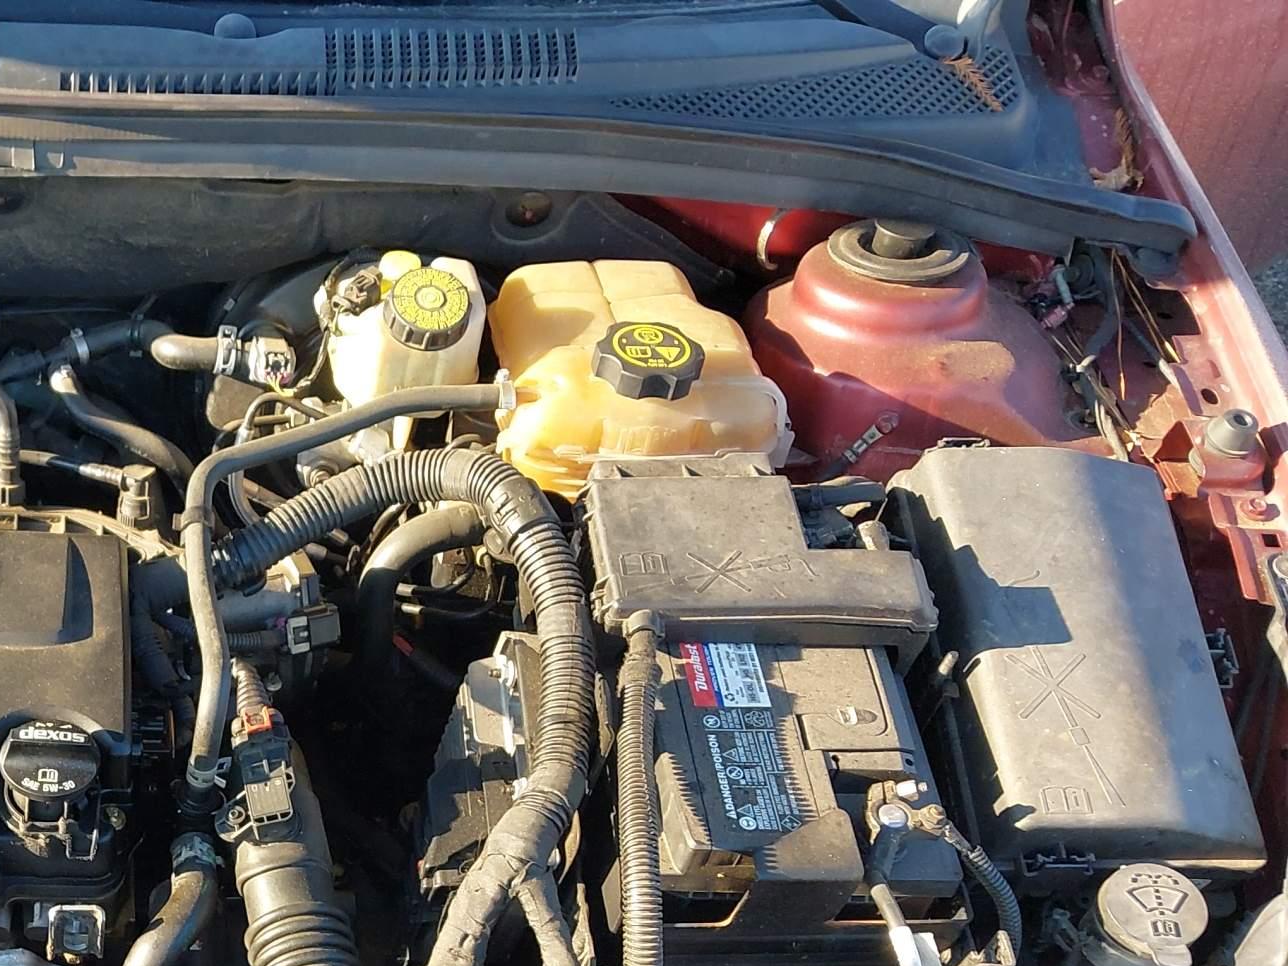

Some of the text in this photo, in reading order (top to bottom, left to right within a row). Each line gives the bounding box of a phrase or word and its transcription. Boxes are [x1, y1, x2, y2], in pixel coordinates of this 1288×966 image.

[684, 643, 709, 692] Duralast
[18, 726, 89, 743] dexos
[21, 777, 76, 792] SAE 5W-30
[707, 734, 736, 814] DANGER/POISON
